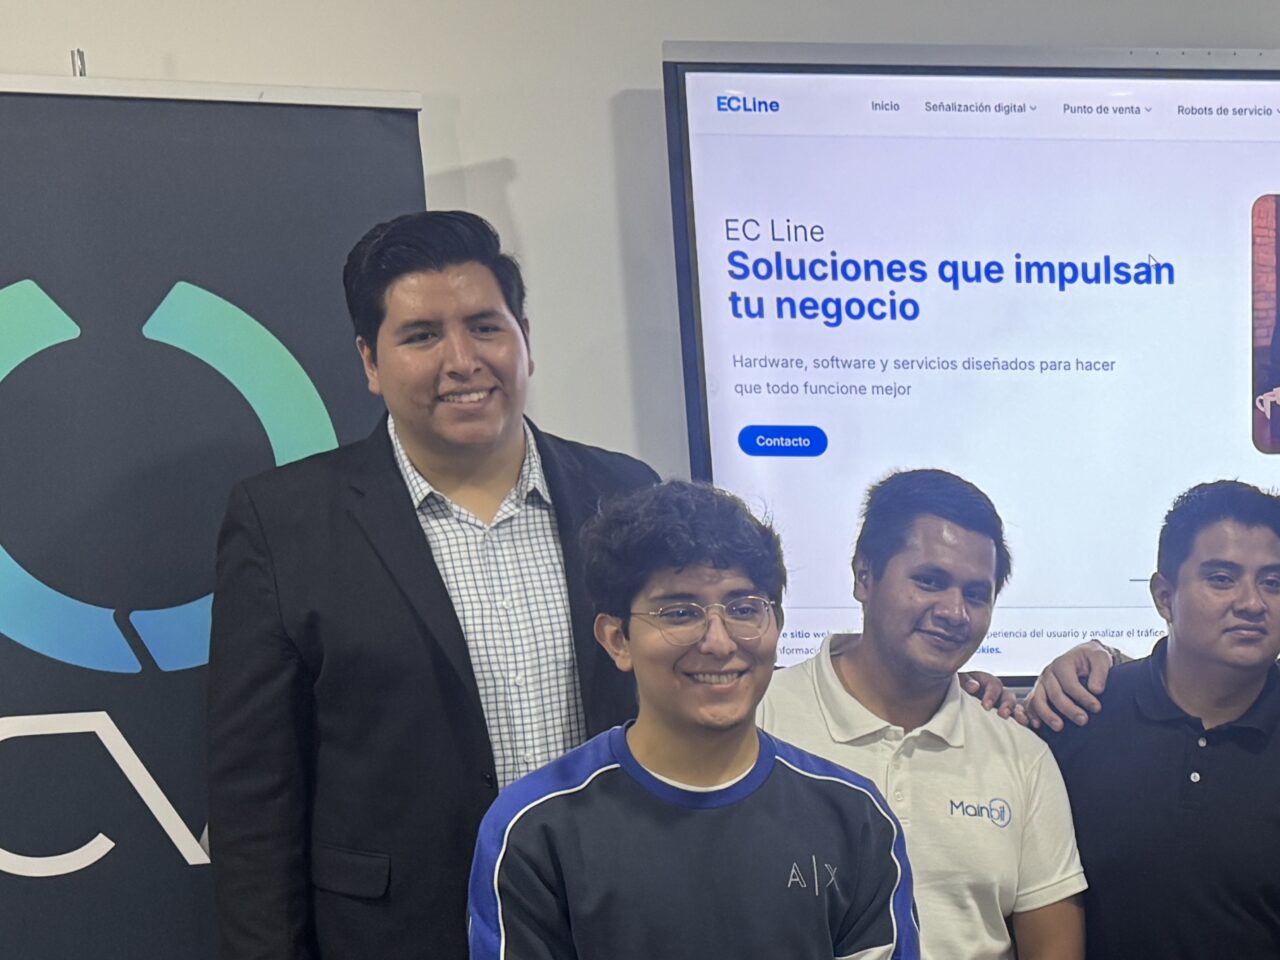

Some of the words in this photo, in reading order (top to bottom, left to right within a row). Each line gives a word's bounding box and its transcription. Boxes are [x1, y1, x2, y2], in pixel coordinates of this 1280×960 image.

[716, 95, 780, 113] ECLine
[871, 99, 900, 112] Inicio
[924, 100, 991, 114] Señalización
[994, 101, 1027, 117] digital
[1063, 103, 1093, 115] Punto
[1095, 104, 1110, 115] de
[1112, 105, 1141, 116] venta
[1177, 104, 1213, 116] Robots
[1215, 104, 1229, 116] de
[1231, 104, 1273, 117] servicio
[725, 219, 762, 242] EC
[771, 219, 825, 242] Line
[726, 250, 928, 282] Soluciones
[937, 259, 1004, 290] que
[1014, 252, 1175, 292] impulsan
[729, 291, 765, 320] tu
[776, 291, 921, 328] negocio
[732, 354, 808, 372] Hardware,
[812, 354, 876, 371] software
[879, 359, 889, 373] y
[893, 356, 958, 372] servicios
[962, 356, 1036, 372] diseñados
[1040, 360, 1072, 375] para
[1075, 357, 1116, 372] hacer
[734, 383, 762, 399] que
[766, 381, 799, 395] todo
[803, 381, 866, 397] funcione
[871, 382, 911, 399] mejor
[755, 435, 811, 448] Contacto
[790, 629, 811, 639] sitio
[986, 630, 1027, 639] periencia
[1030, 629, 1044, 638] del
[1046, 629, 1080, 638] usuario
[1081, 630, 1088, 640] y
[1089, 629, 1124, 638] analizar
[1126, 629, 1135, 638] el
